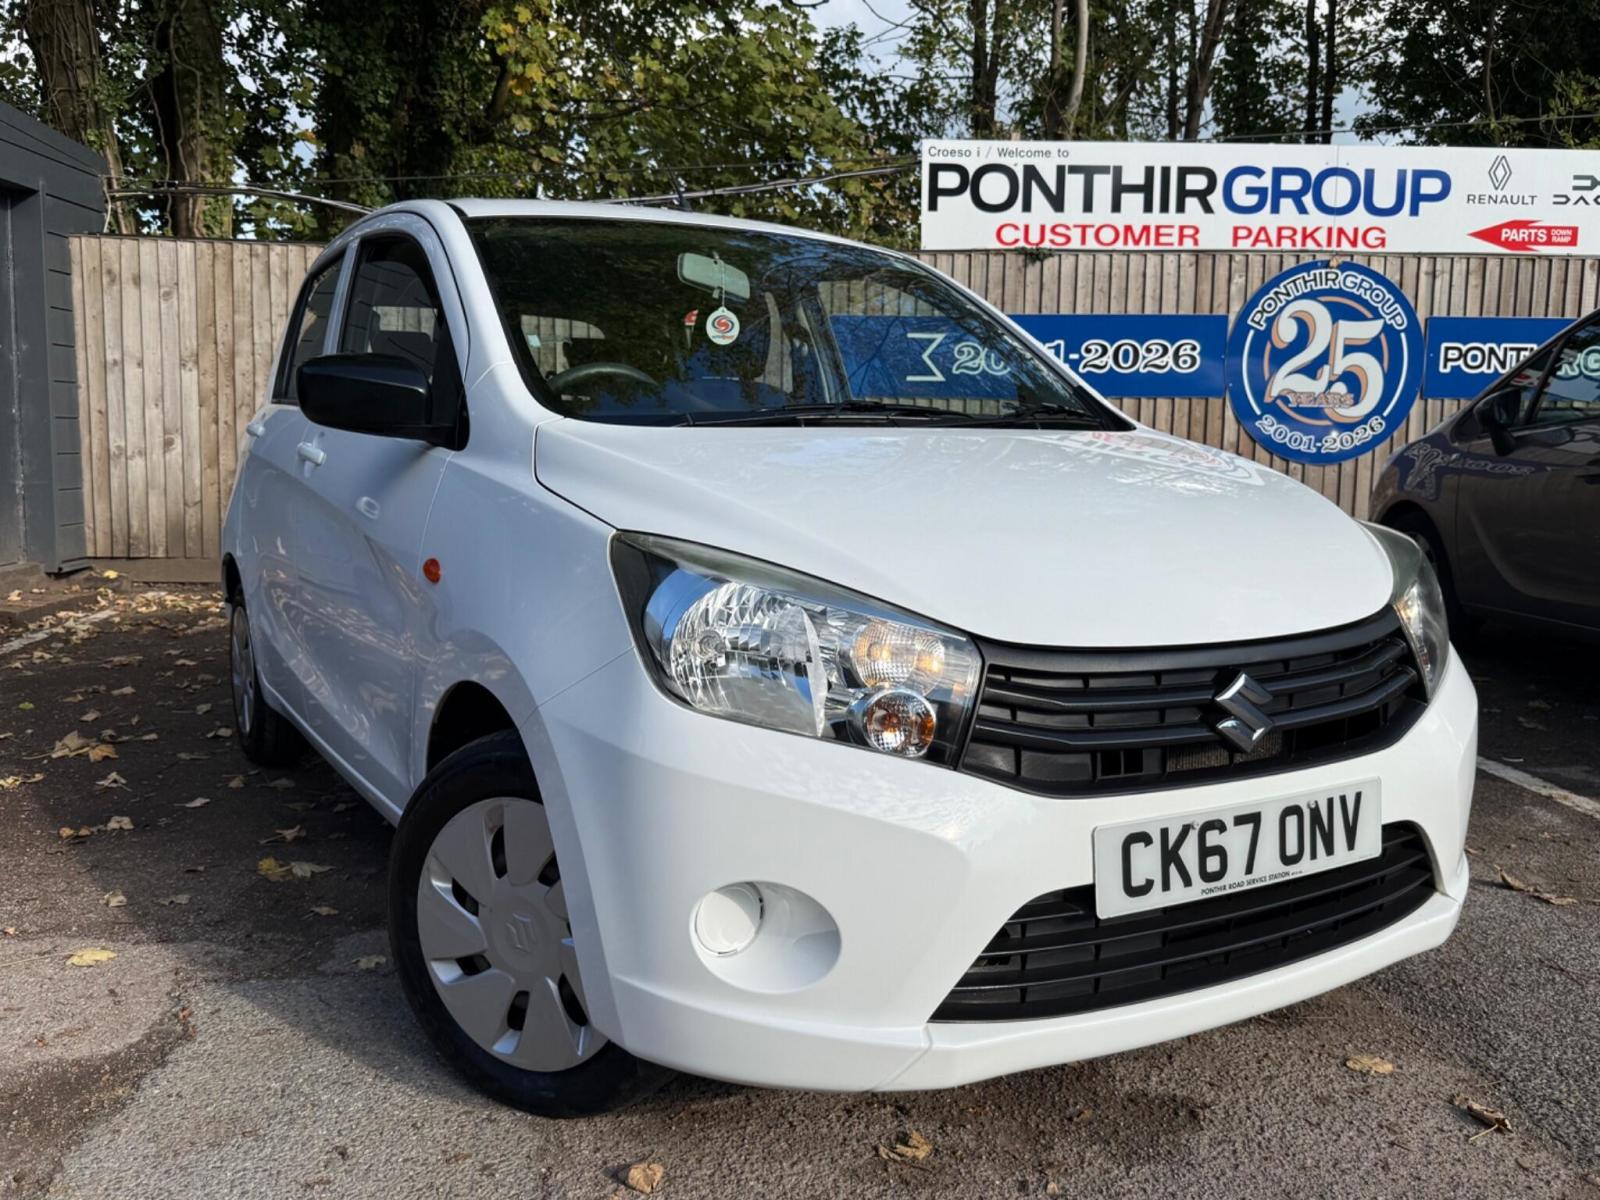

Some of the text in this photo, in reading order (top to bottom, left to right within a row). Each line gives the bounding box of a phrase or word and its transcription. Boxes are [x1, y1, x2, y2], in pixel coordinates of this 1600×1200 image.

[928, 146, 972, 158] Croeso
[997, 147, 1051, 158] Welcome
[1057, 148, 1070, 158] to
[1466, 194, 1538, 205] RENAULT
[995, 223, 1387, 250] CUSTOMER PARKING
[1501, 229, 1547, 242] PARTS
[1551, 235, 1572, 243] RAMP
[1264, 299, 1384, 422] 25
[1256, 414, 1385, 453] 2001-2026
[1121, 791, 1362, 898] CK67 ONV
[1228, 881, 1245, 889] ROAD
[1246, 876, 1267, 885] SERVICE
[1268, 871, 1290, 880] STATION
